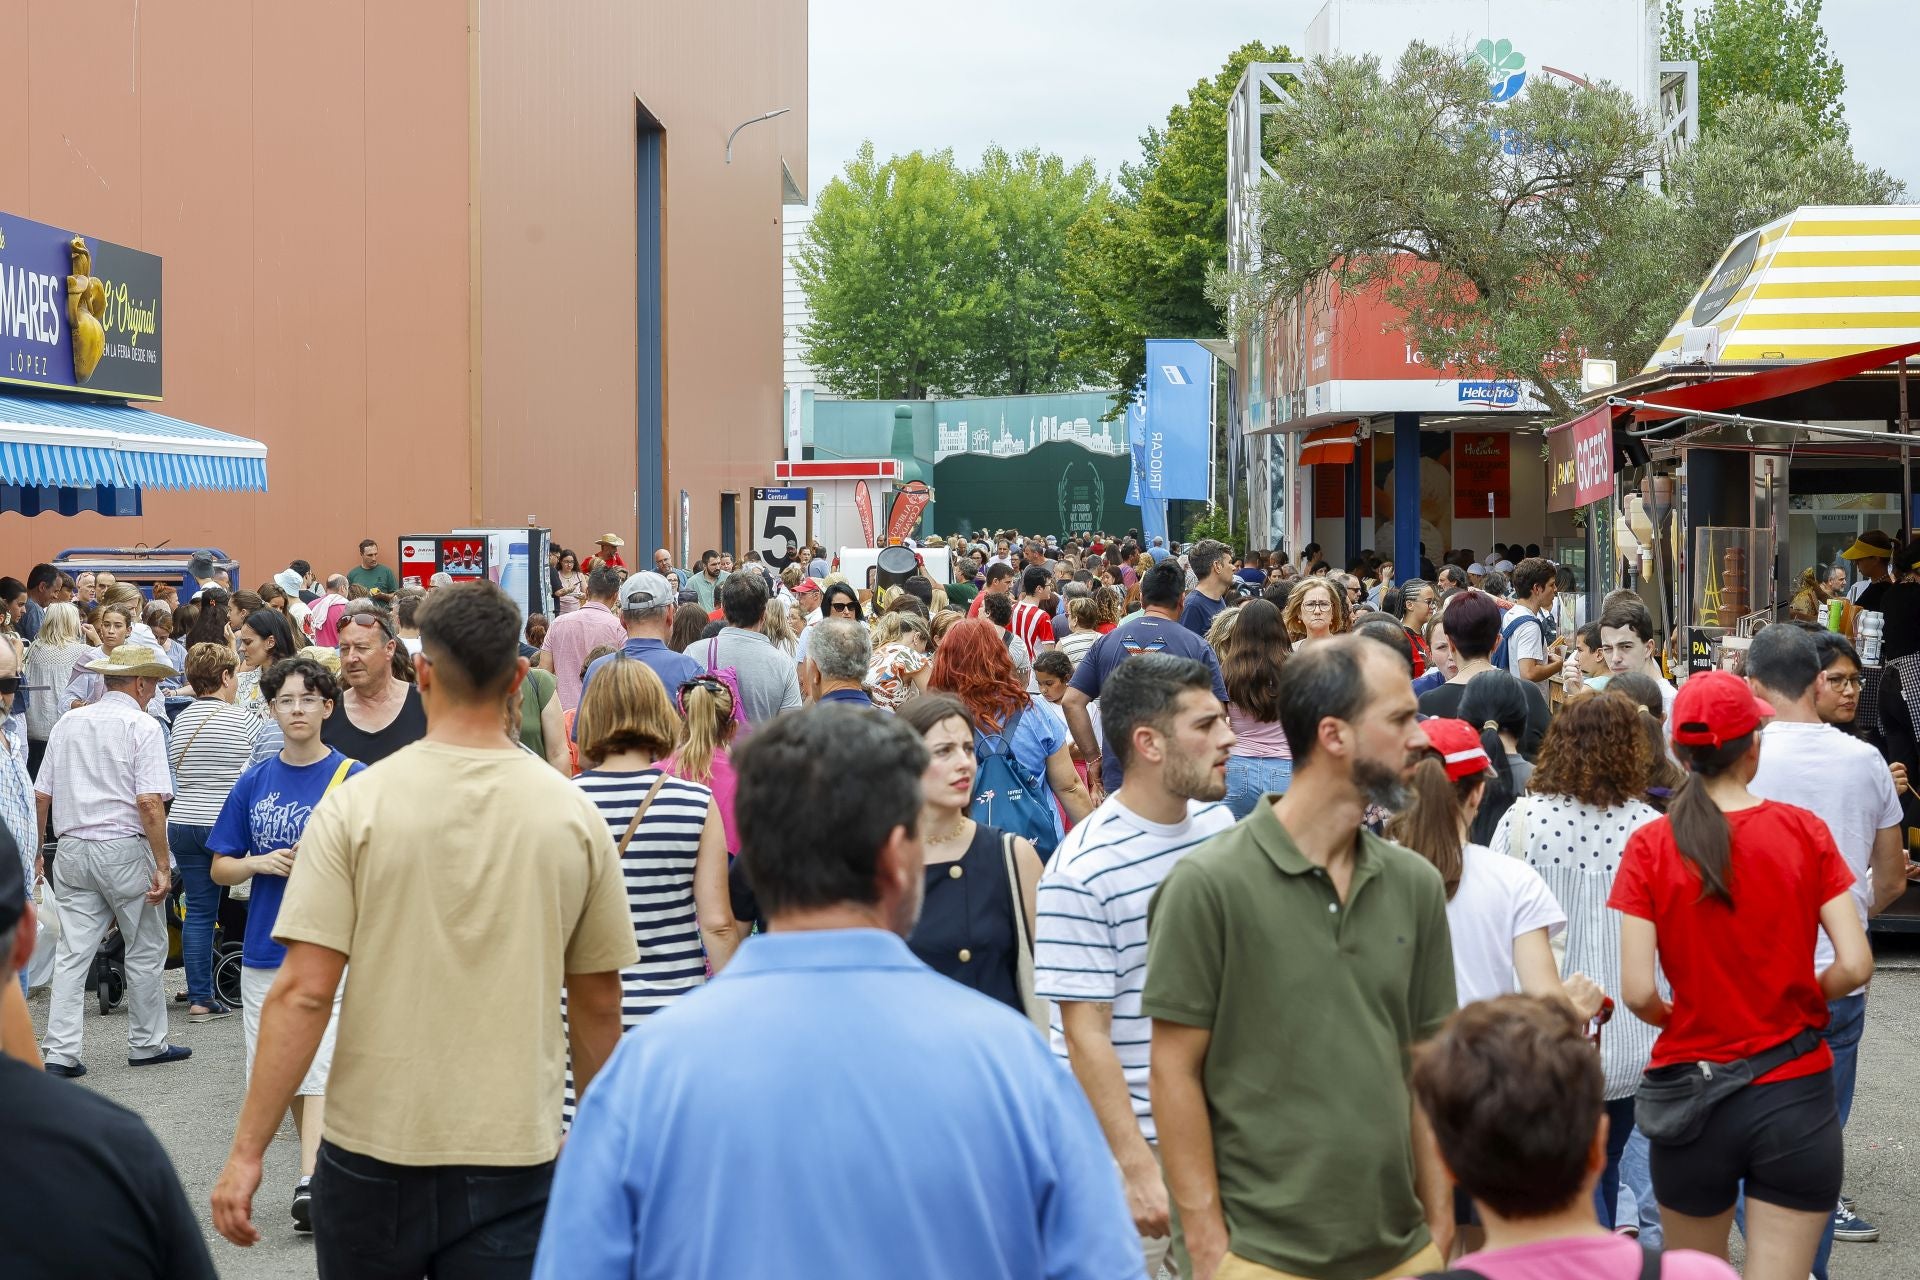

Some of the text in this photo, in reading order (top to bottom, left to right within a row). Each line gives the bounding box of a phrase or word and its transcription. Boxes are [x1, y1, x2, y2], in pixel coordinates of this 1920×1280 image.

[116, 283, 155, 346] Original
[10, 349, 47, 376] LÓPEZ
[110, 344, 117, 358] LA
[118, 344, 130, 359] FERIA
[132, 347, 145, 362] DESDE
[757, 489, 764, 499] 5
[762, 506, 797, 569] 5
